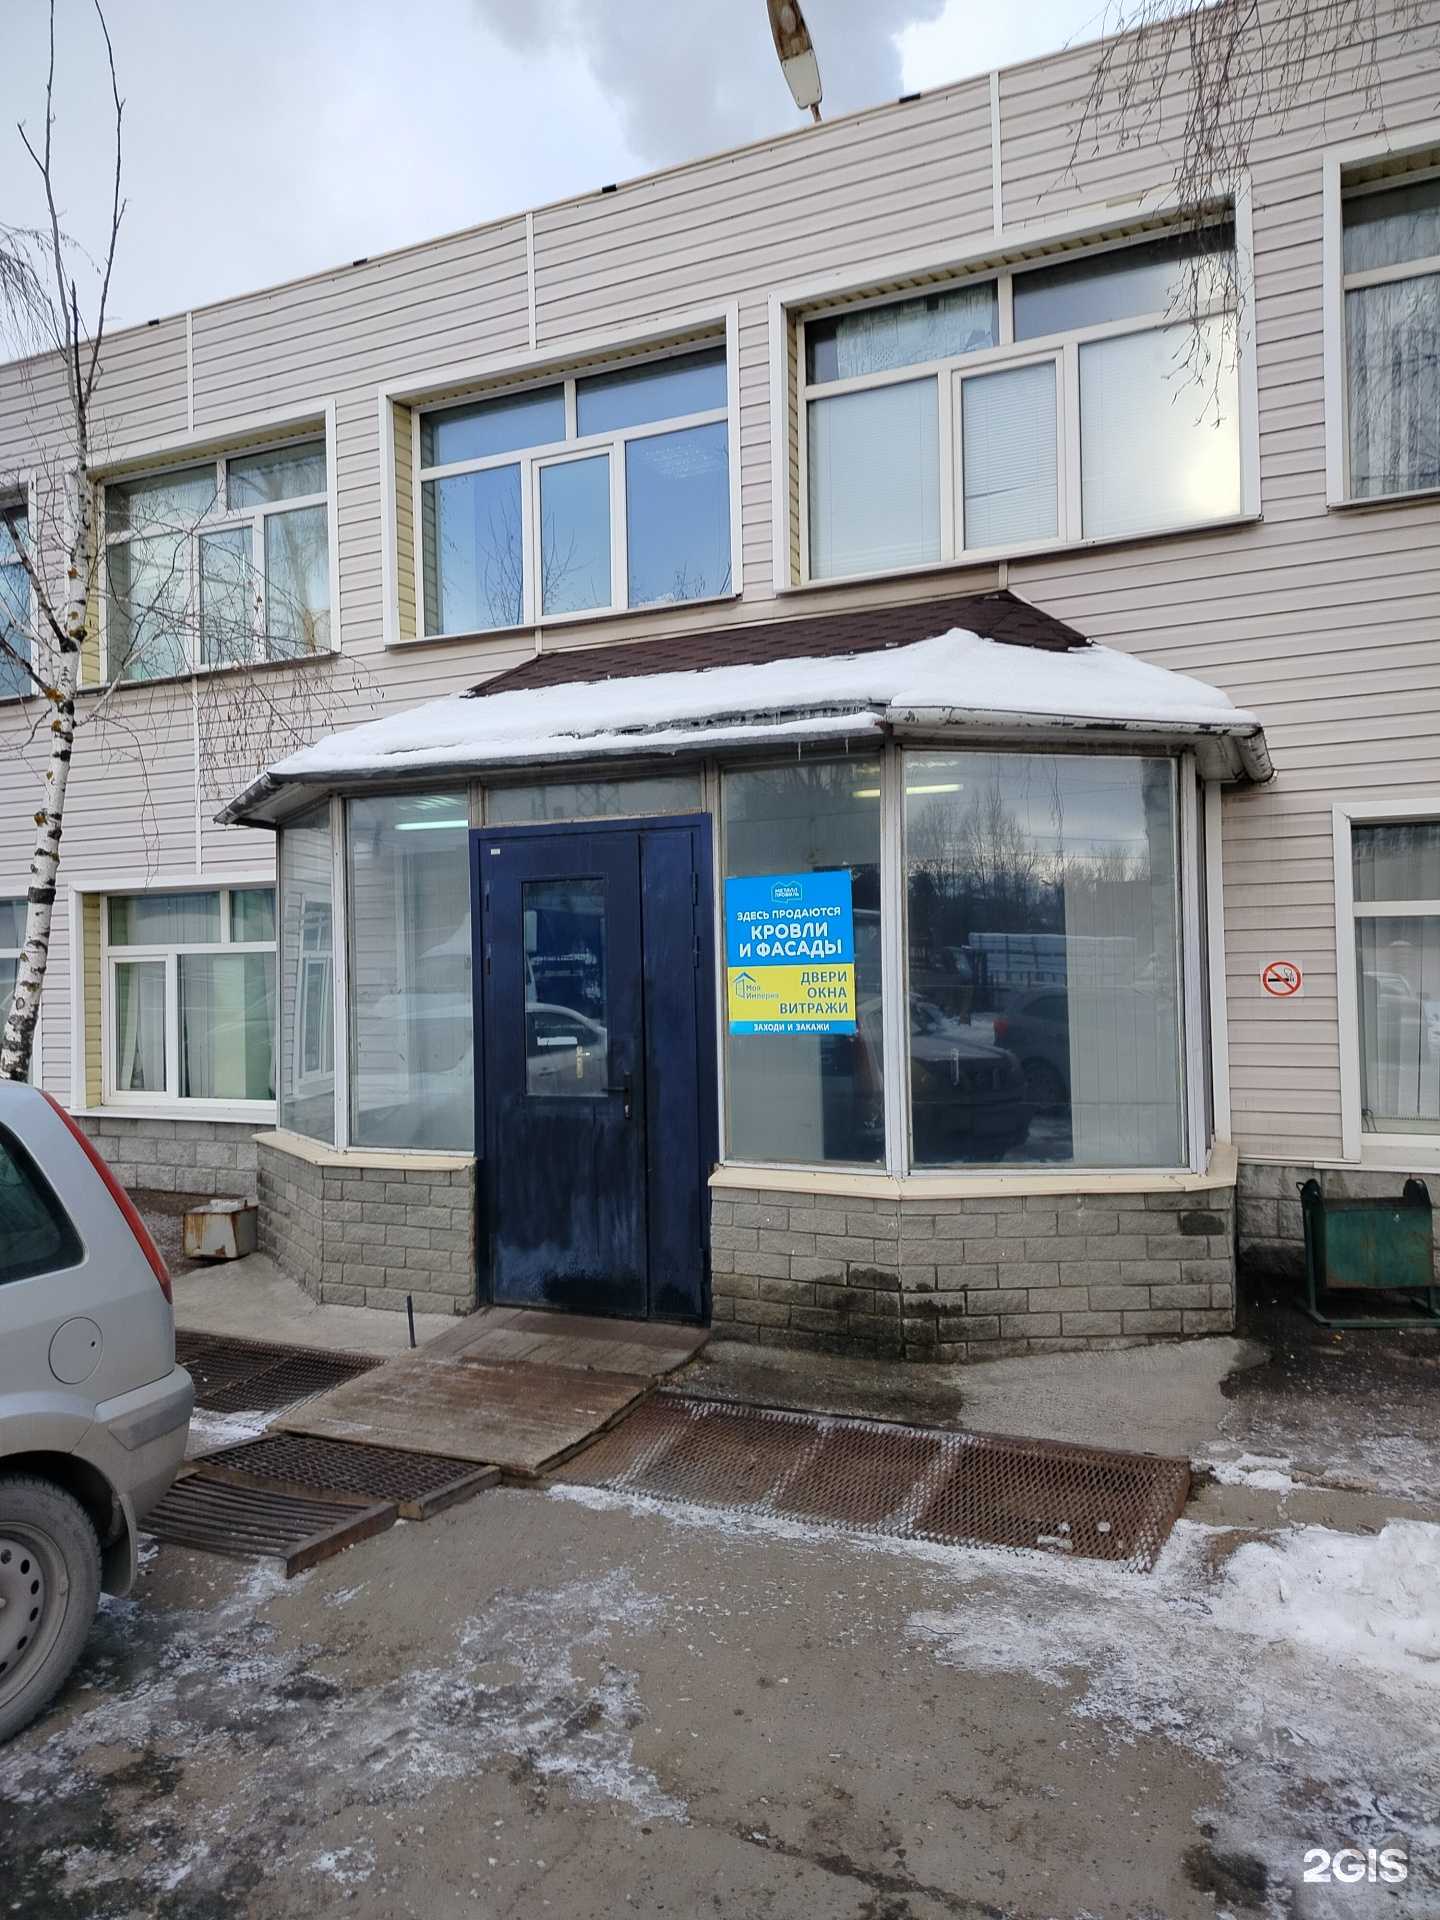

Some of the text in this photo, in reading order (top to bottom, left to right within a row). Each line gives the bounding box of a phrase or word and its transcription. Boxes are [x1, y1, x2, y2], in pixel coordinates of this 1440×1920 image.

[737, 907, 840, 922] ЗДЕСЬ ПРОДАЮТСЯ
[751, 922, 828, 940] КРОВЛИ
[739, 939, 842, 958] И ФАСАДЫ
[801, 971, 847, 985] ДВЕРИ
[807, 987, 847, 998] ОКНА
[780, 1003, 848, 1014] ВИТРАЖИ
[753, 1023, 829, 1032] ЗАХОДИ И ЗАКАЖИ
